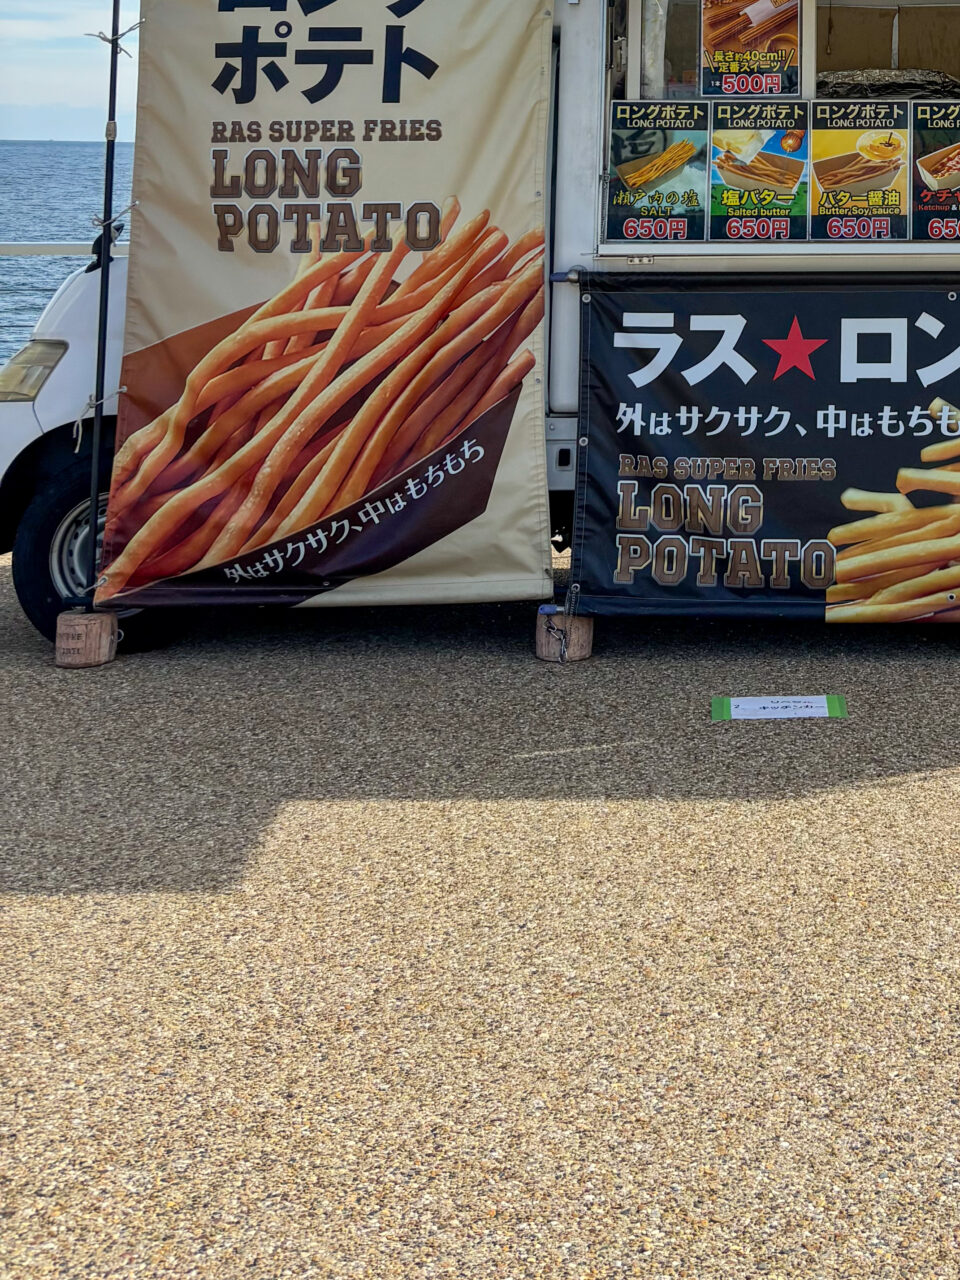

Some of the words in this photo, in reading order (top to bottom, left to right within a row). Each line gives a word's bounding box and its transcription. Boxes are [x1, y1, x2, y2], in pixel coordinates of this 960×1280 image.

[211, 21, 440, 104] ポテト
[718, 61, 780, 73] 定番スイーツ
[722, 74, 781, 93] 500円
[616, 104, 704, 119] ロングポテト
[717, 104, 804, 119] ロングポテト
[816, 104, 904, 119] ロングポテト
[211, 121, 262, 144] RAS
[269, 120, 356, 143] SUPER
[362, 120, 442, 142] FRIES
[627, 119, 654, 128] LONG
[656, 119, 694, 128] POTATO
[728, 119, 755, 128] LONG
[757, 119, 795, 128] POTATO
[827, 119, 854, 127] LONG
[856, 119, 894, 127] POTATO
[928, 119, 955, 128] LONG
[210, 147, 363, 200] LONG
[721, 189, 795, 206] 塩バター
[819, 189, 900, 206] バター醤油
[640, 206, 673, 216] SALT
[727, 207, 758, 216] Salted
[760, 207, 791, 216] butter
[819, 206, 850, 215] Butter
[852, 206, 869, 216] Soy
[872, 207, 900, 215] sauce
[212, 201, 443, 254] POTATO
[623, 217, 687, 239] 650円
[726, 217, 790, 239] 650円
[827, 217, 891, 238] 650円
[613, 312, 758, 388] ラス
[618, 454, 667, 478] RAS
[673, 456, 756, 481] SUPER
[763, 458, 837, 481] FRIES
[224, 438, 485, 584] 外はサクサク、中はもちもち
[615, 480, 764, 535] LONG
[613, 533, 838, 590] POTATO
